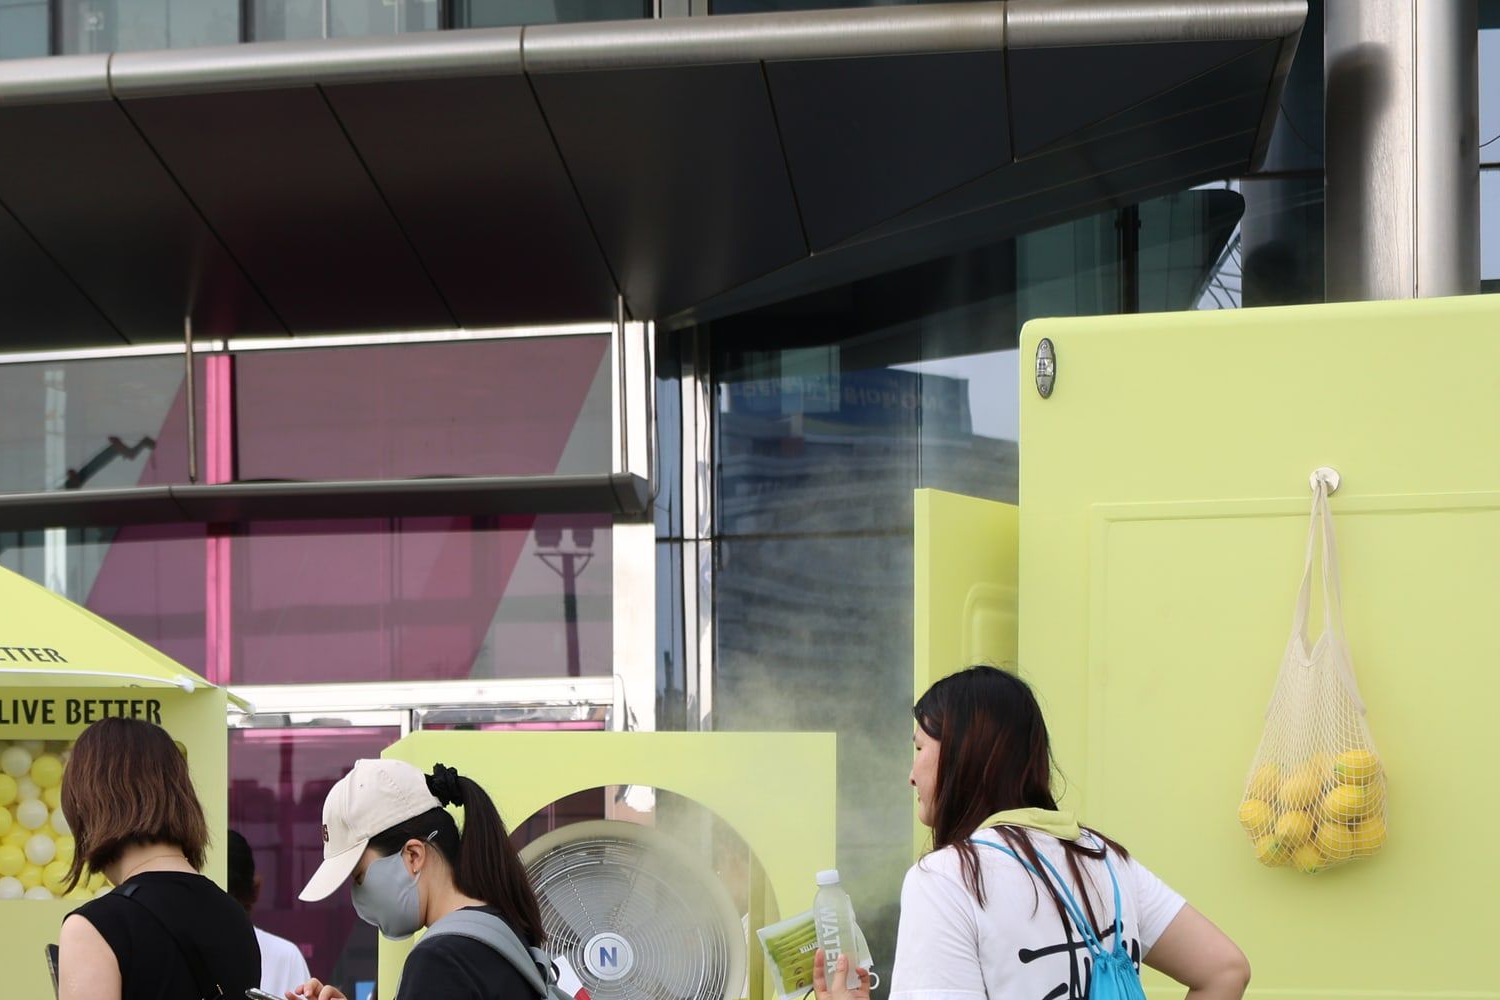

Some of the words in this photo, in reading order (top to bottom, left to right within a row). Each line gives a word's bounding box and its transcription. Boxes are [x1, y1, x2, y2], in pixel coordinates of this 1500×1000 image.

[66, 699, 162, 725] BETTER
[820, 908, 842, 973] WATER
[599, 946, 618, 968] N
